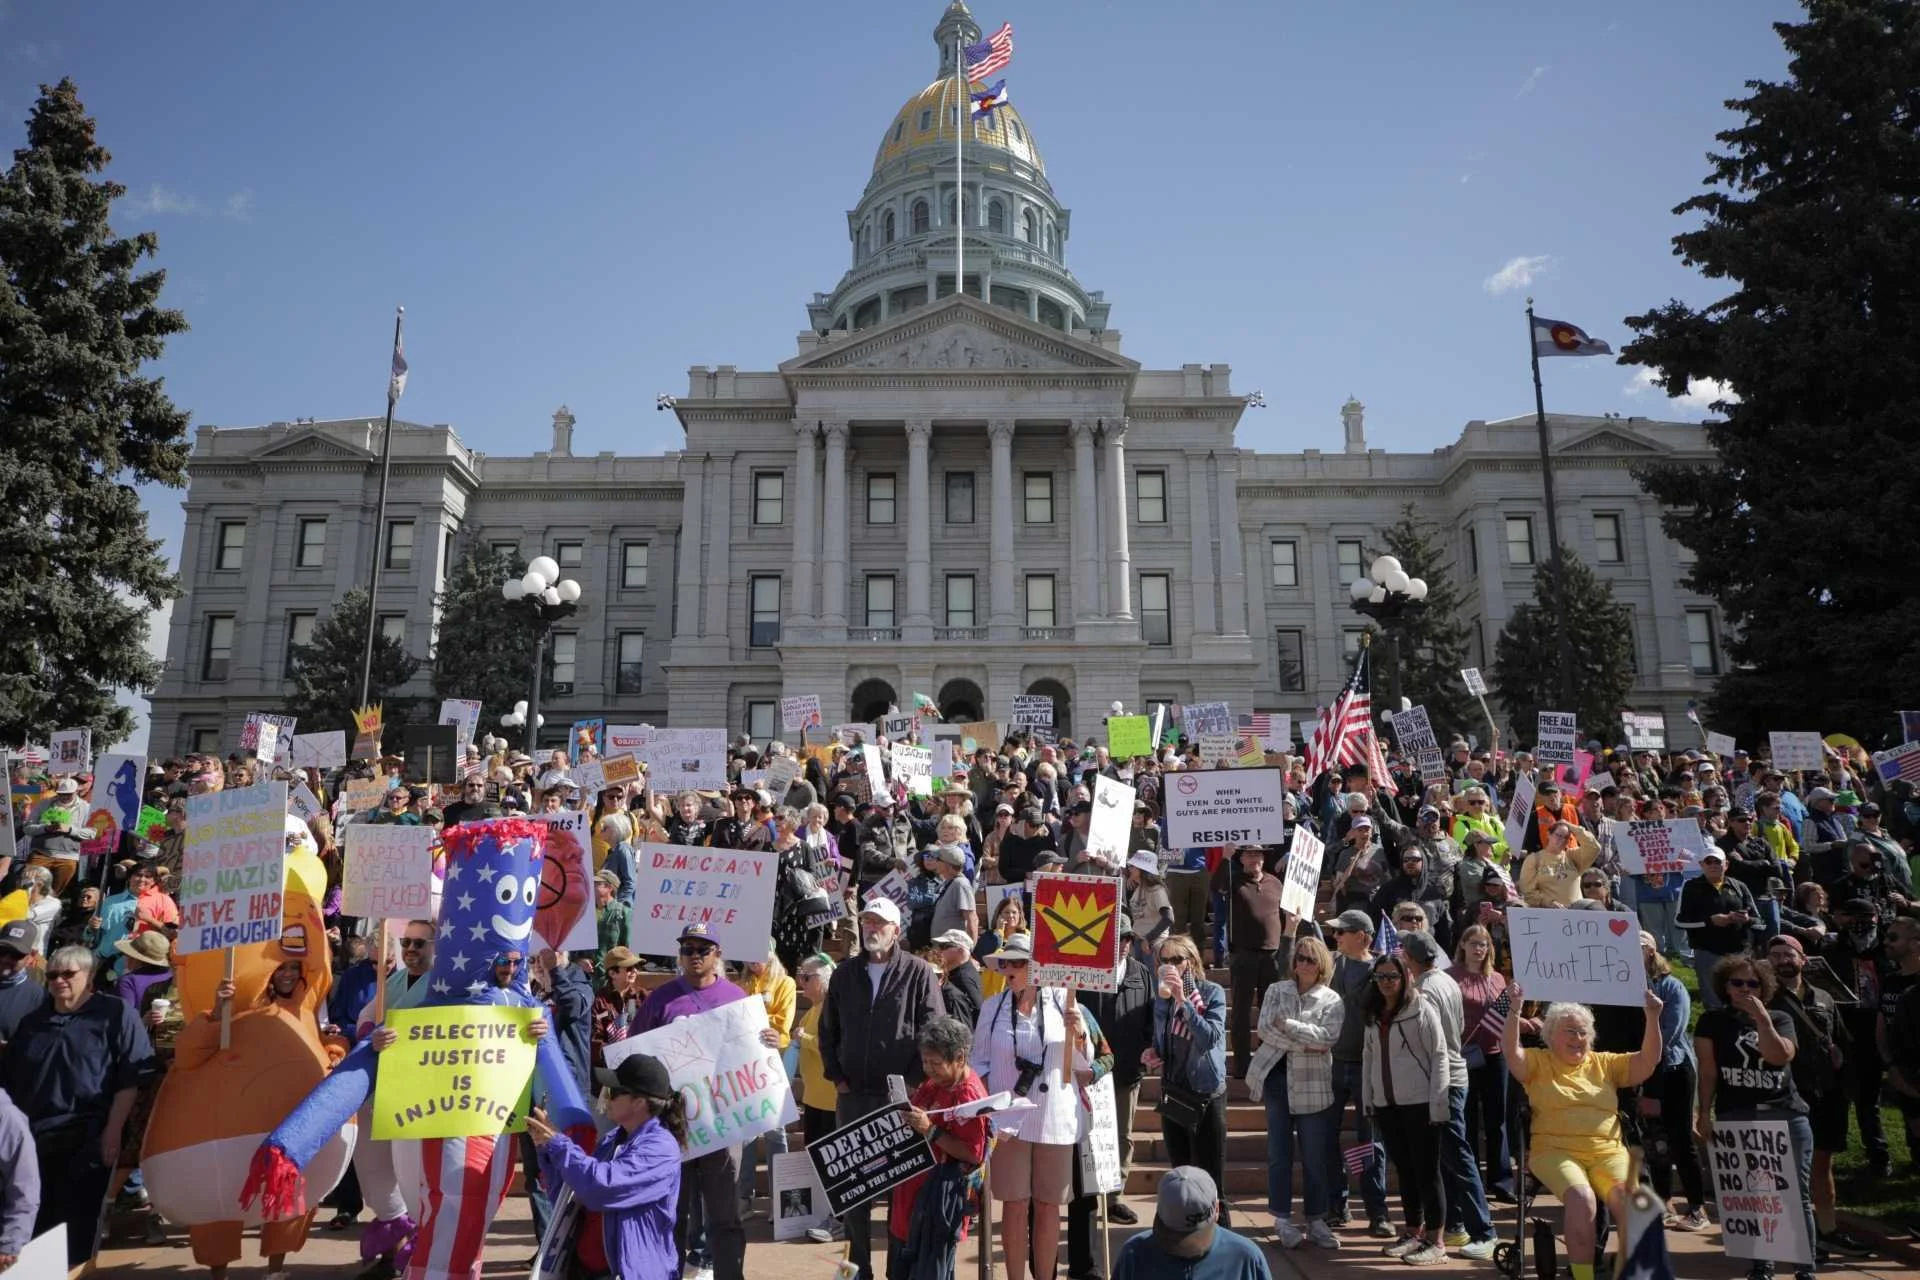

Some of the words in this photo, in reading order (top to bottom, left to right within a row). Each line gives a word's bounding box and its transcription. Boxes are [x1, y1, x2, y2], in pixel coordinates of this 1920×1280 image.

[363, 715, 378, 729] NO
[886, 716, 920, 733] NOPE
[1399, 724, 1413, 736] END
[1414, 719, 1429, 731] THE
[1540, 715, 1558, 726] FREE
[1560, 716, 1573, 727] ALL
[1402, 734, 1434, 753] NOW!
[1540, 740, 1573, 751] POLITICAL
[1420, 752, 1442, 763] FIGHT
[1540, 750, 1574, 760] PRISONERS
[1216, 788, 1241, 796] WHEN
[1176, 809, 1199, 817] GUYS
[1202, 808, 1218, 816] ARE
[1221, 806, 1276, 815] PROTESTING
[1186, 799, 1209, 807] EVEN
[1214, 798, 1231, 806] OLD
[1236, 797, 1263, 805] WHITE
[1192, 829, 1251, 843] RESIST
[356, 845, 420, 866] RAPIST
[1295, 829, 1319, 864] STOP
[652, 853, 762, 877] DEMOCRACY
[216, 862, 278, 894] NAZIS
[660, 879, 709, 897] DIES
[716, 882, 742, 899] IN
[248, 892, 282, 920] HAD
[650, 903, 738, 924] SILENCE
[200, 919, 279, 951] ENOUGH!
[1520, 917, 1542, 936] I
[1562, 918, 1599, 937] am
[1040, 969, 1066, 981] DUMP
[1070, 970, 1106, 985] TRUMP
[408, 1023, 518, 1041] SELECTIVE
[418, 1048, 506, 1066] JUSTICE
[452, 1074, 472, 1091] IS
[703, 1055, 784, 1115] KINGS
[1720, 1066, 1785, 1089] RESIST
[394, 1093, 517, 1128] INJUSTICE
[818, 1108, 907, 1165] DEFUND
[1712, 1128, 1737, 1149] NO
[1739, 1128, 1789, 1156] KING
[826, 1124, 915, 1178] OLIGARCHS
[1715, 1151, 1740, 1171] NO
[1746, 1152, 1783, 1173] DON
[840, 1183, 866, 1203] FUND
[866, 1172, 888, 1189] THE
[887, 1153, 926, 1179] PEOPLE
[1719, 1174, 1743, 1191] NO
[1722, 1195, 1783, 1214] ORANGE
[1726, 1217, 1762, 1237] CON
